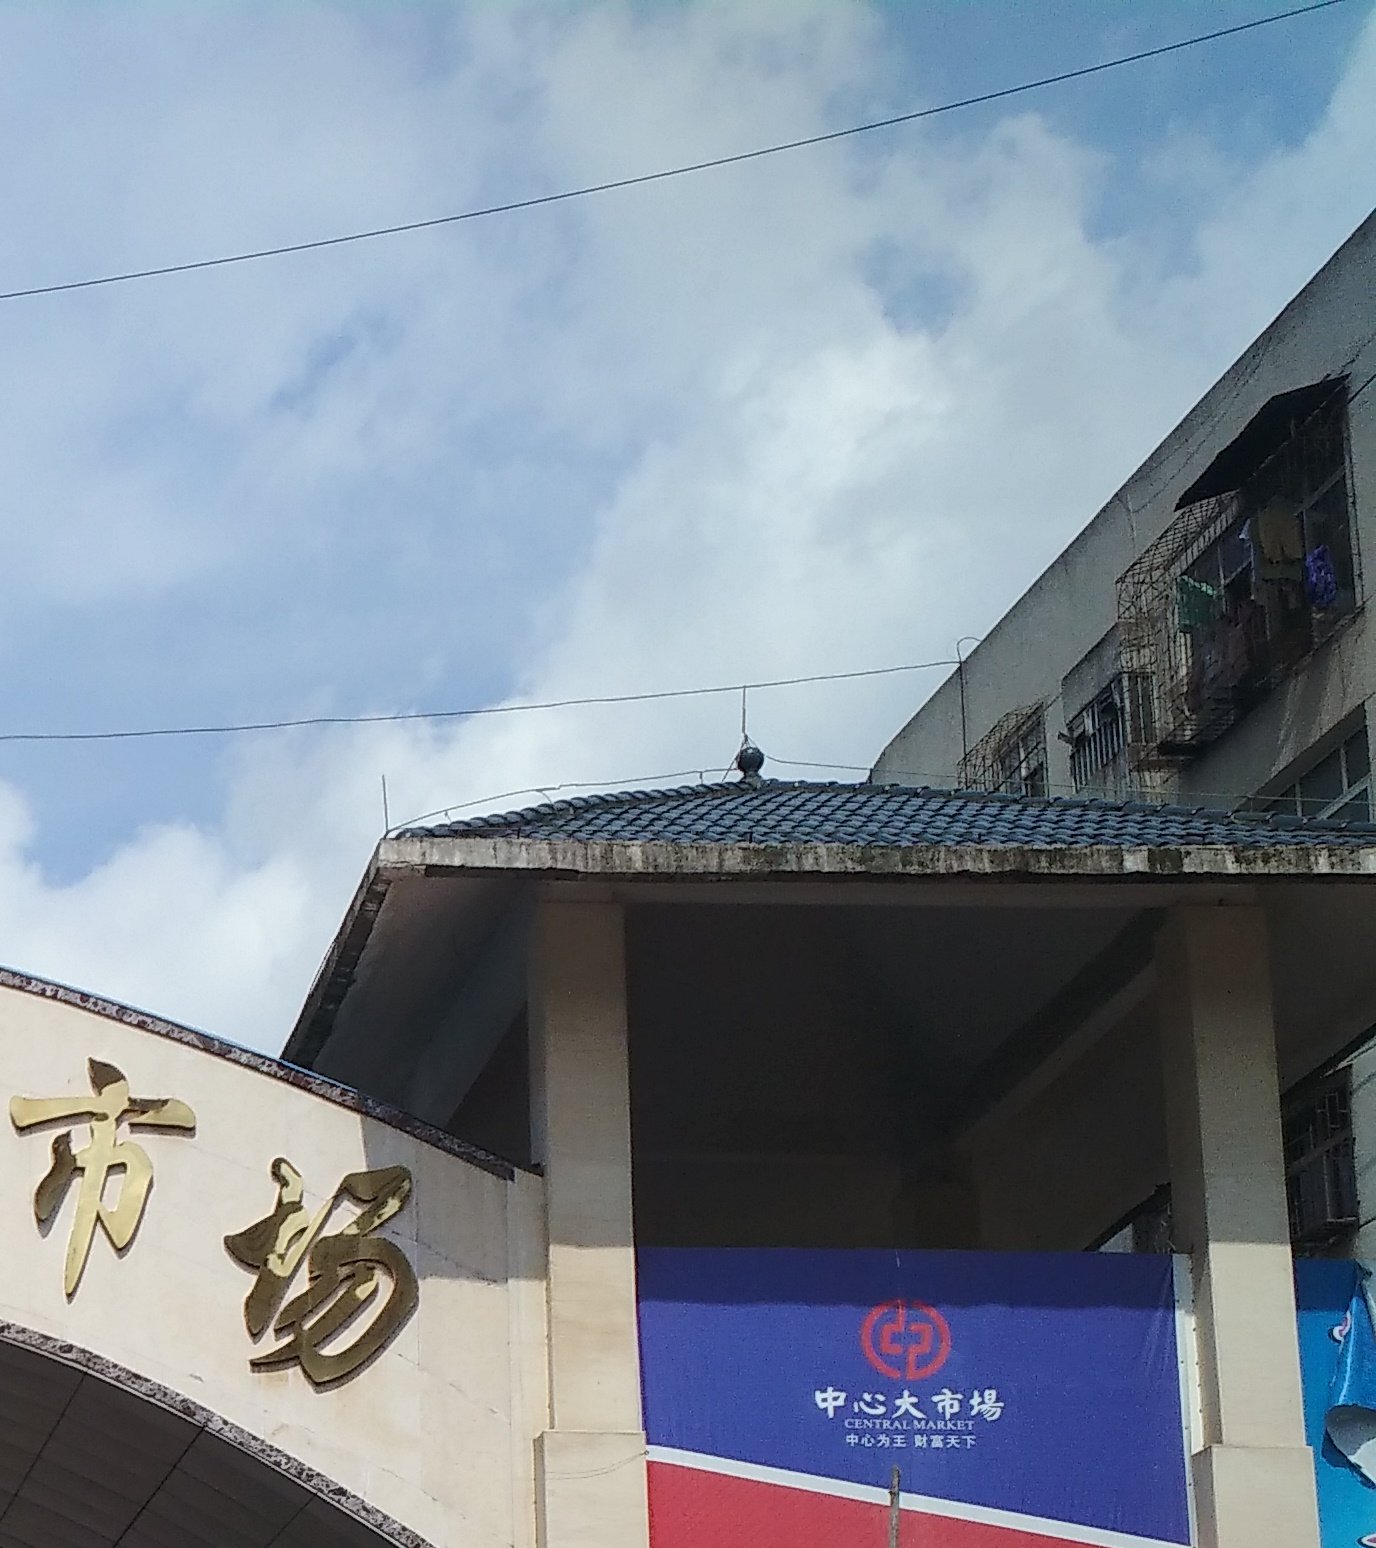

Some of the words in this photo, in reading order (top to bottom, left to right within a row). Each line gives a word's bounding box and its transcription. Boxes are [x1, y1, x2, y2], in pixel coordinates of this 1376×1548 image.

[814, 1386, 1005, 1422] 中心大市場
[845, 1418, 911, 1430] CENTRAL
[914, 1419, 975, 1431] MARKET
[846, 1433, 907, 1448] 中心为王
[914, 1434, 977, 1449] 财富天下
